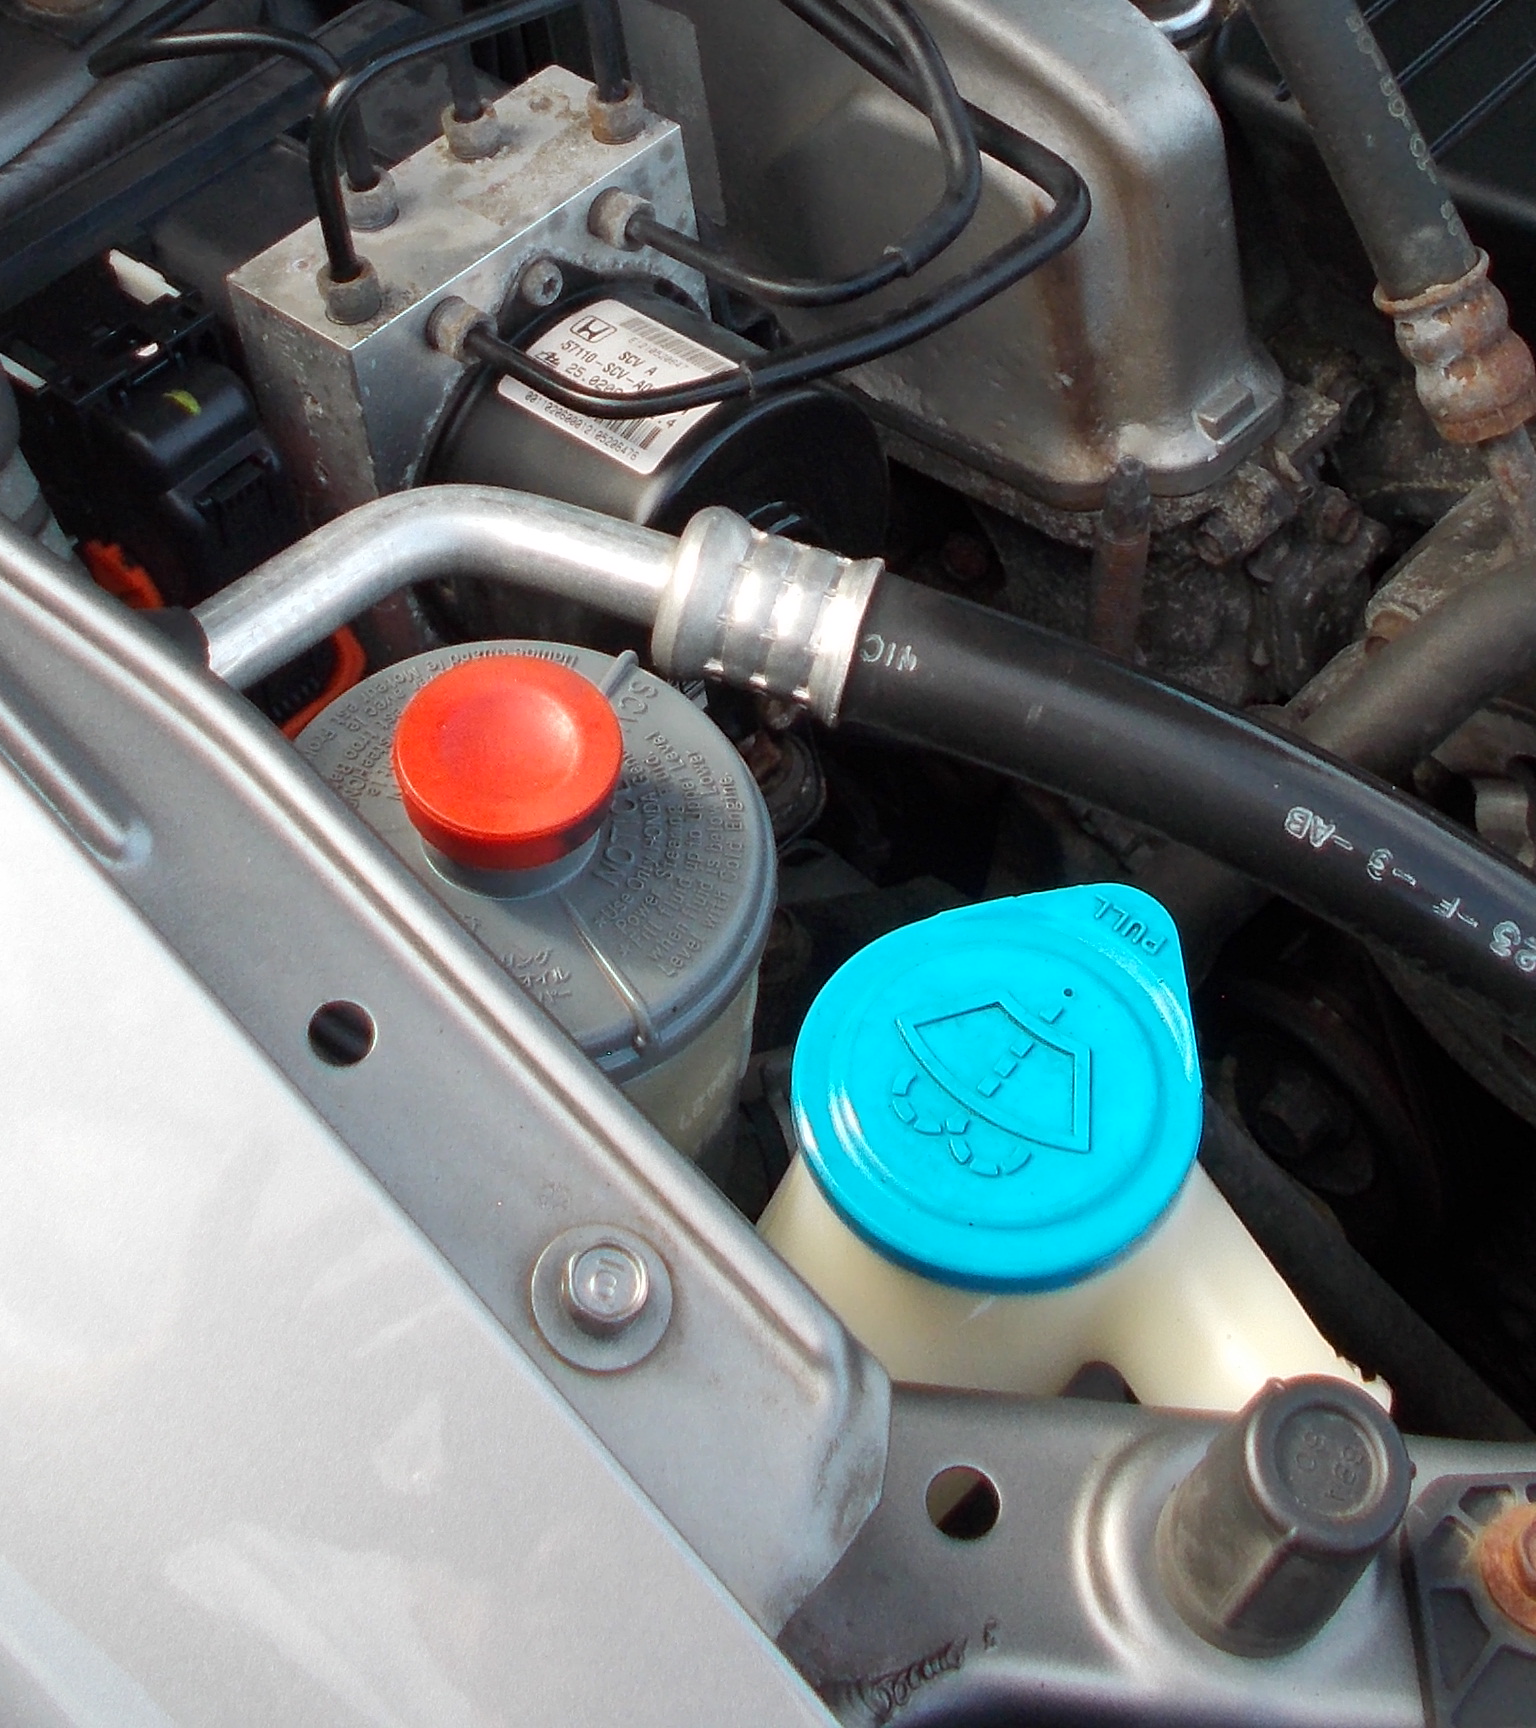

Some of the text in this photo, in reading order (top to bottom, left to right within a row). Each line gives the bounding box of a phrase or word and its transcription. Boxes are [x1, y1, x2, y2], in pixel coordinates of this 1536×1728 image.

[618, 350, 658, 376] SCV A
[686, 750, 720, 795] Lower
[615, 890, 662, 934] Power
[1094, 892, 1168, 959] PULL
[659, 936, 707, 979] Level
